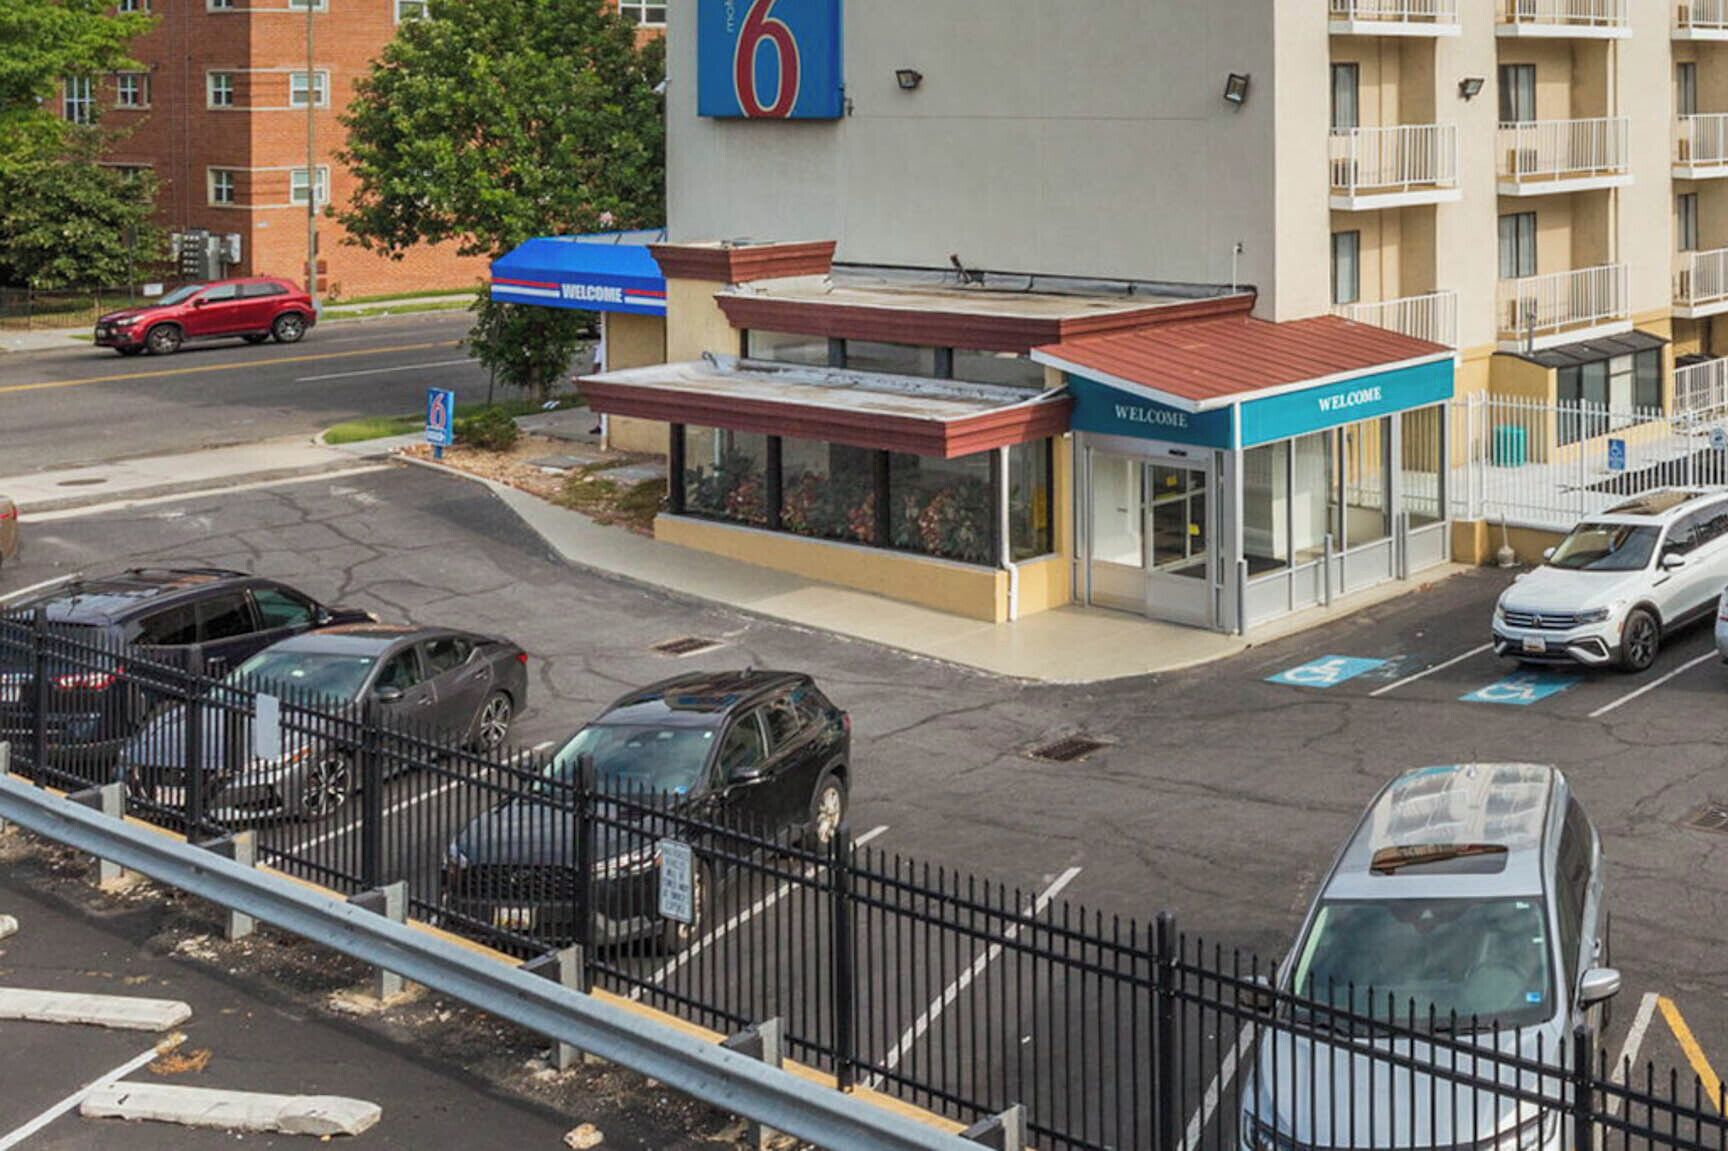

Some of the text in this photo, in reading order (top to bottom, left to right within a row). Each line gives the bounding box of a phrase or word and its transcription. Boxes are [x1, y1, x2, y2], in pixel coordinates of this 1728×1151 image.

[561, 283, 624, 303] WELCOME
[1318, 386, 1382, 412] WELCOME
[1115, 404, 1188, 428] WELCOME
